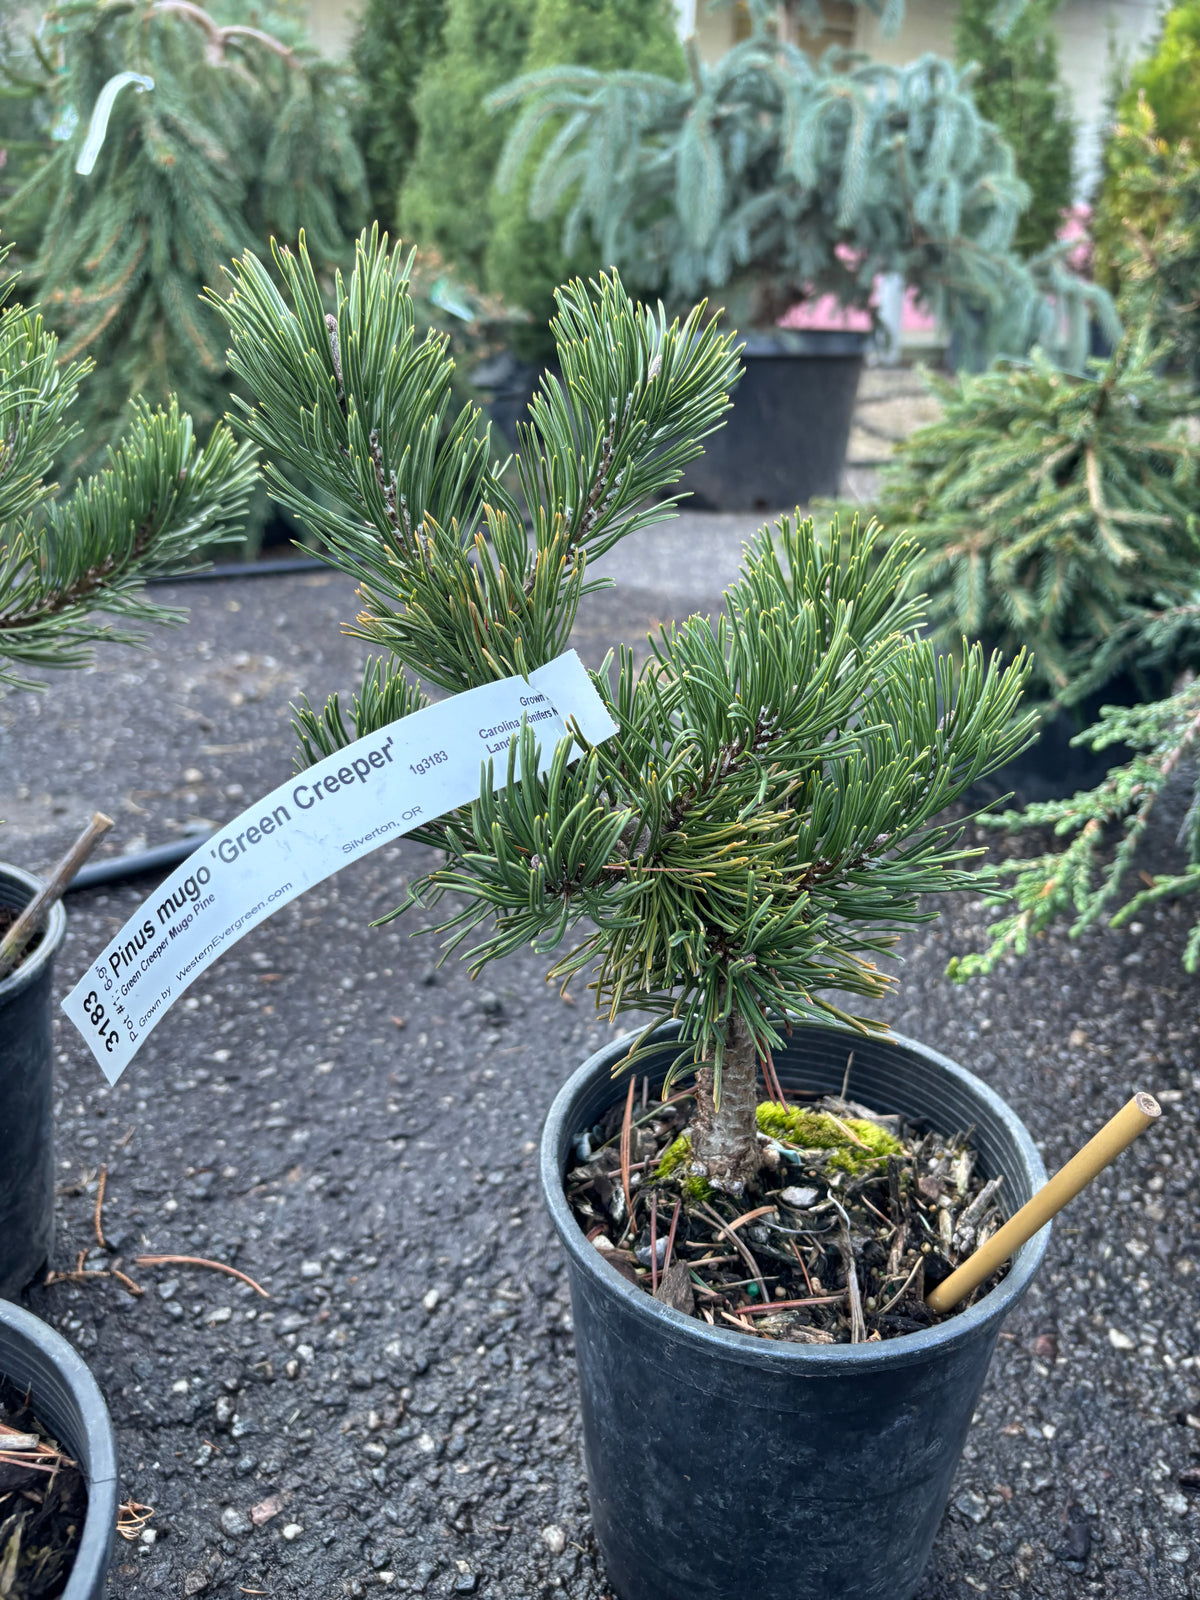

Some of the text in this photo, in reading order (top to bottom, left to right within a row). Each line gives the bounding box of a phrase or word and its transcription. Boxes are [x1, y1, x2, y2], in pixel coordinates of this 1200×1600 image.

[479, 719, 520, 739] Carolina
[520, 709, 553, 724] onifers
[519, 694, 545, 706] Grown
[409, 750, 449, 775] 1g3183
[342, 806, 424, 854] Silverton, OR
[108, 736, 394, 979] Pinus mugo 'Green Creeper'
[121, 893, 216, 996] Green Creeper Mugo Pine
[139, 882, 293, 1027] Grown by WesternEvergreen.com
[83, 990, 120, 1053] 3183
[123, 1014, 139, 1042] Pot
